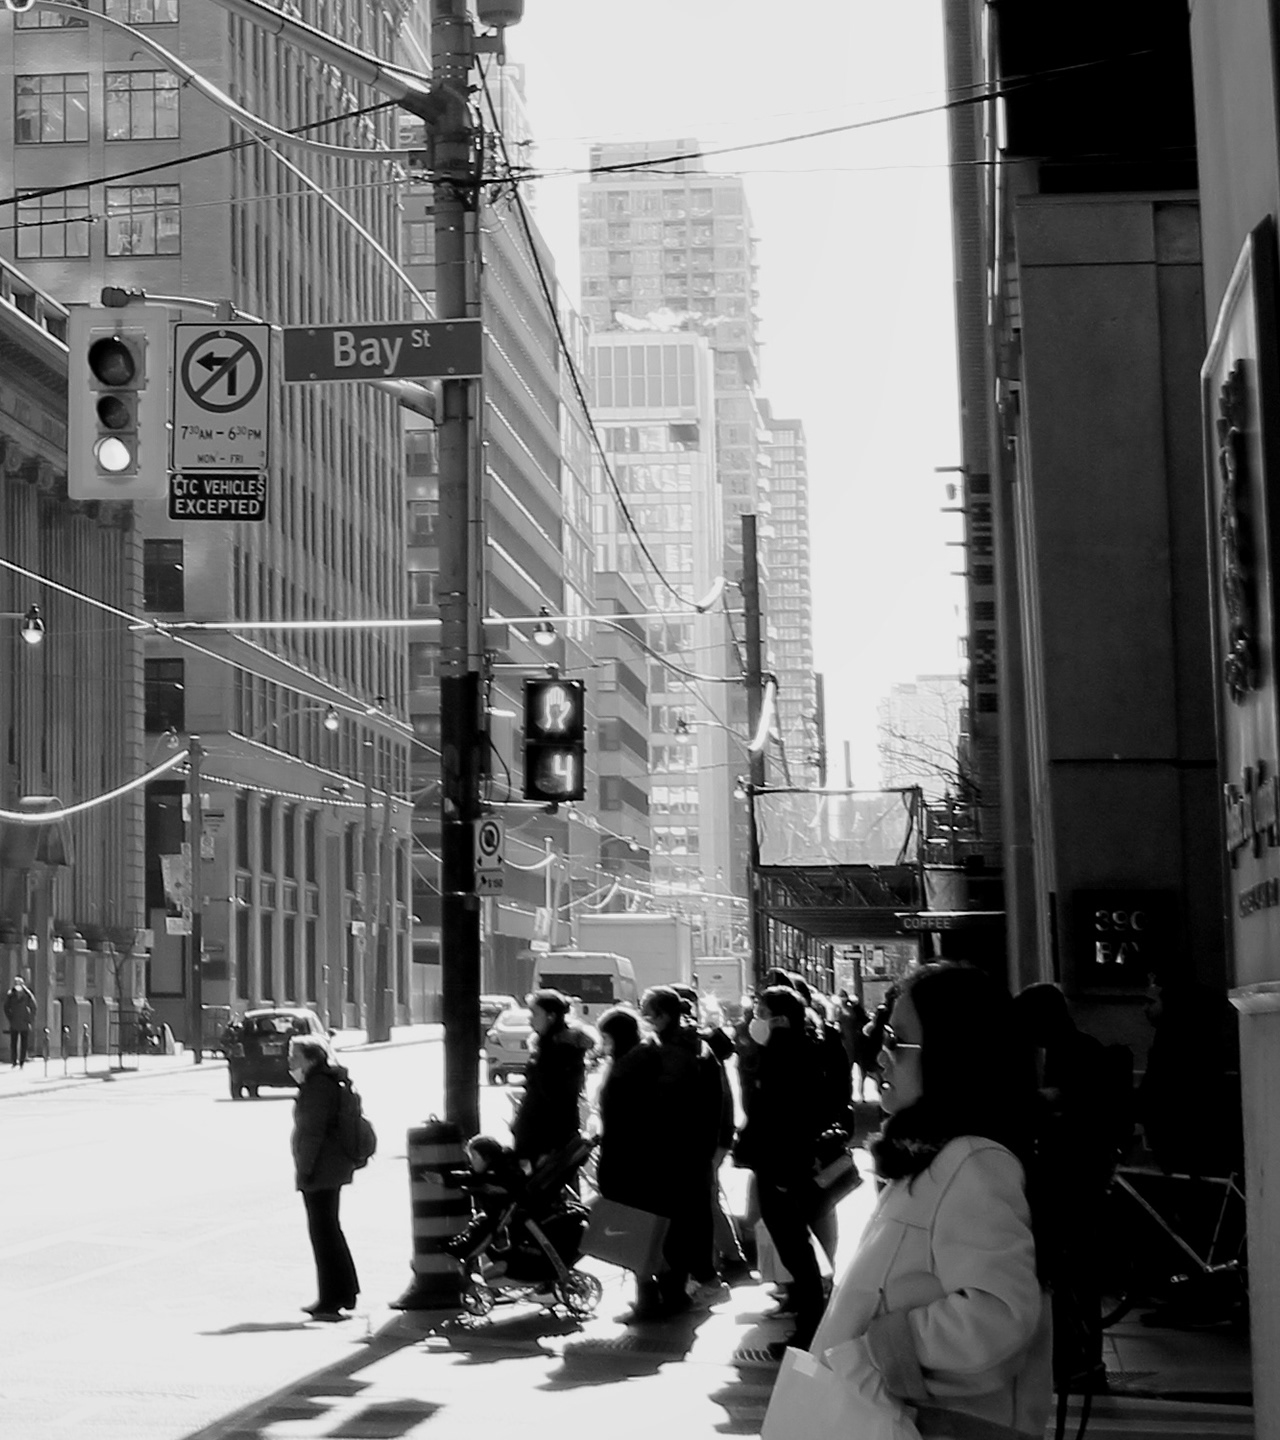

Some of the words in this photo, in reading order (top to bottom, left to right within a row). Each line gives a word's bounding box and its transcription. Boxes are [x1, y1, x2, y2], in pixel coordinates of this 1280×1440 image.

[333, 330, 404, 376] Bay
[411, 328, 431, 348] St
[197, 454, 216, 463] MON
[230, 454, 244, 463] FRI
[172, 479, 199, 495] TTC
[203, 480, 265, 495] VEHICLES
[175, 499, 260, 514] EXCEPTED
[551, 754, 574, 794] 4
[903, 918, 952, 929] COFFEE
